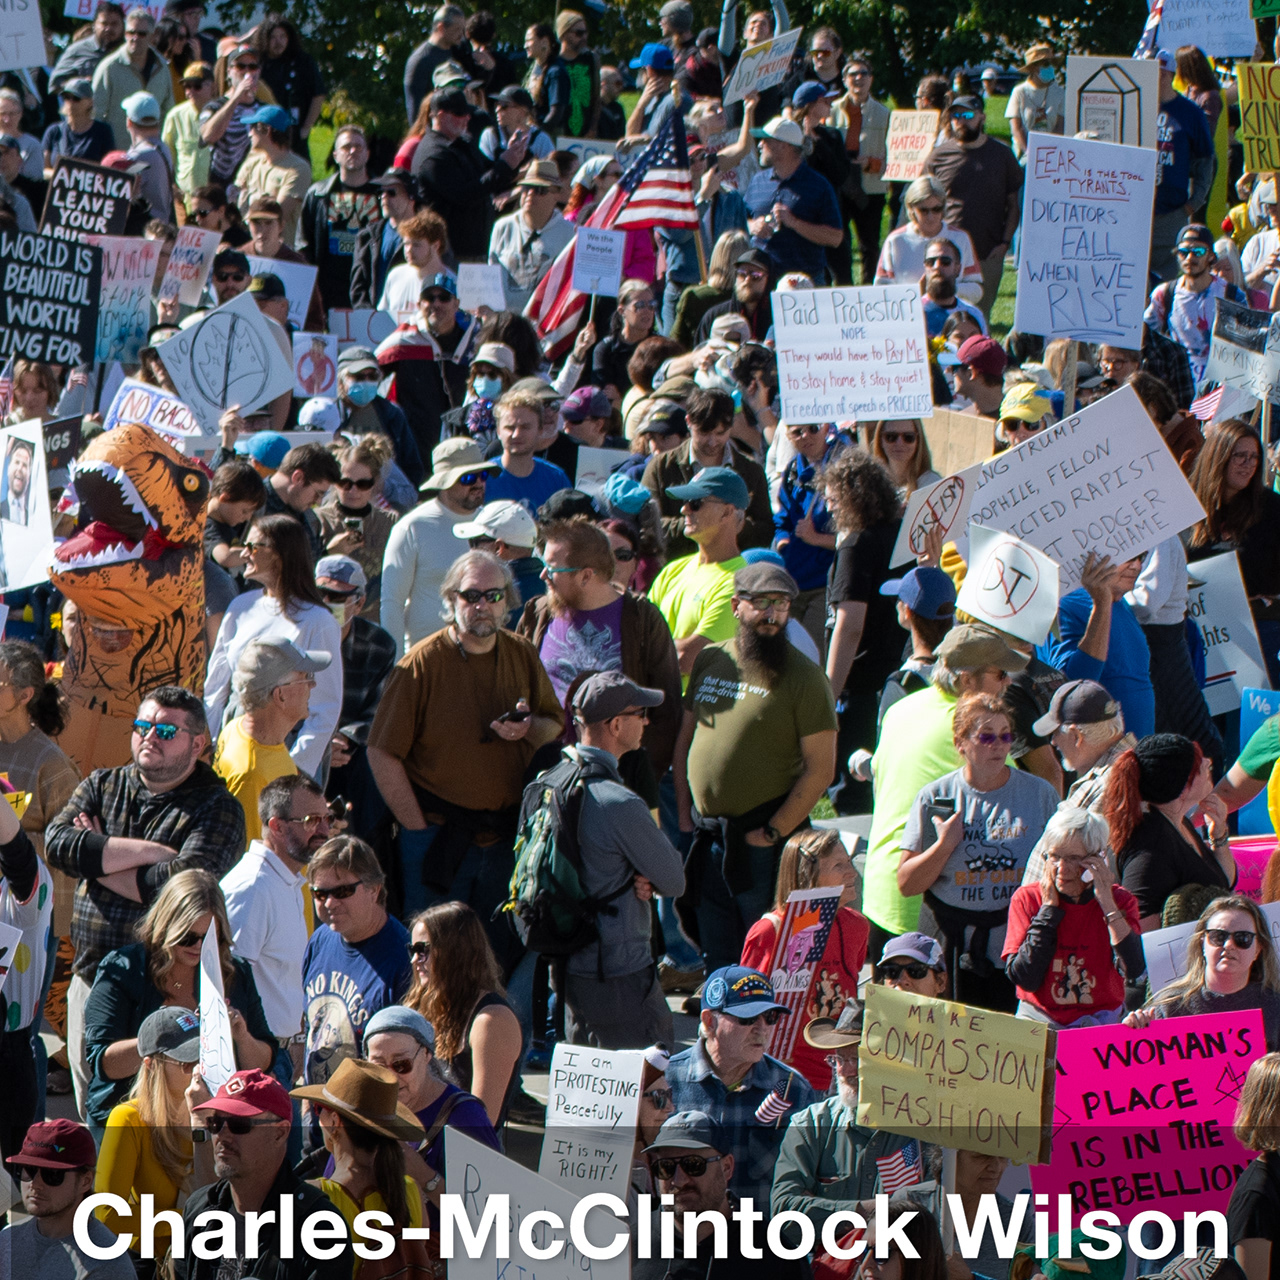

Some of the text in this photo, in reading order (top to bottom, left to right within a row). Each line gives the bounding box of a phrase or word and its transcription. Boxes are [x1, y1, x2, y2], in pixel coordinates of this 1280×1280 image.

[1035, 146, 1080, 175] FEAR
[1097, 171, 1117, 179] THE
[1120, 172, 1144, 181] TOOL
[53, 166, 131, 200] AMERICA
[1064, 179, 1131, 195] TYRANTS.
[52, 189, 114, 219] LEAVE
[1032, 199, 1118, 224] DICTATORS
[59, 208, 107, 234] YOUR
[1, 233, 68, 268] WORLD
[74, 248, 93, 275] IS
[1061, 226, 1122, 257] FALL
[4, 263, 90, 306] BEAUTIFUL
[1026, 261, 1135, 289] WHEN WE
[6, 297, 81, 334] WORTH
[780, 288, 916, 326] Paid Protestor?
[1047, 284, 1137, 329] RISE.
[841, 327, 867, 340] NOPE
[45, 336, 82, 365] FOR
[780, 350, 810, 368] They
[815, 348, 842, 361] would
[848, 348, 868, 361] have
[872, 345, 882, 360] to
[786, 374, 799, 390] to
[802, 372, 826, 395] stay
[829, 371, 856, 388] home
[870, 371, 890, 392] stay
[894, 369, 923, 393] quiet!
[907, 1003, 987, 1033] MAKE
[563, 1051, 612, 1070] I am
[863, 1021, 1041, 1094] COMPASSION
[1092, 1026, 1253, 1071] WOMAN'S
[554, 1069, 638, 1098] PROTESTING
[925, 1072, 959, 1090] THE
[555, 1093, 623, 1130] Peacefully
[1082, 1077, 1199, 1120] PLACE
[880, 1085, 1024, 1149] FASHION
[552, 1139, 614, 1163] It is my
[1071, 1119, 1226, 1170] IS IN THE
[559, 1158, 618, 1181] RIGHT!
